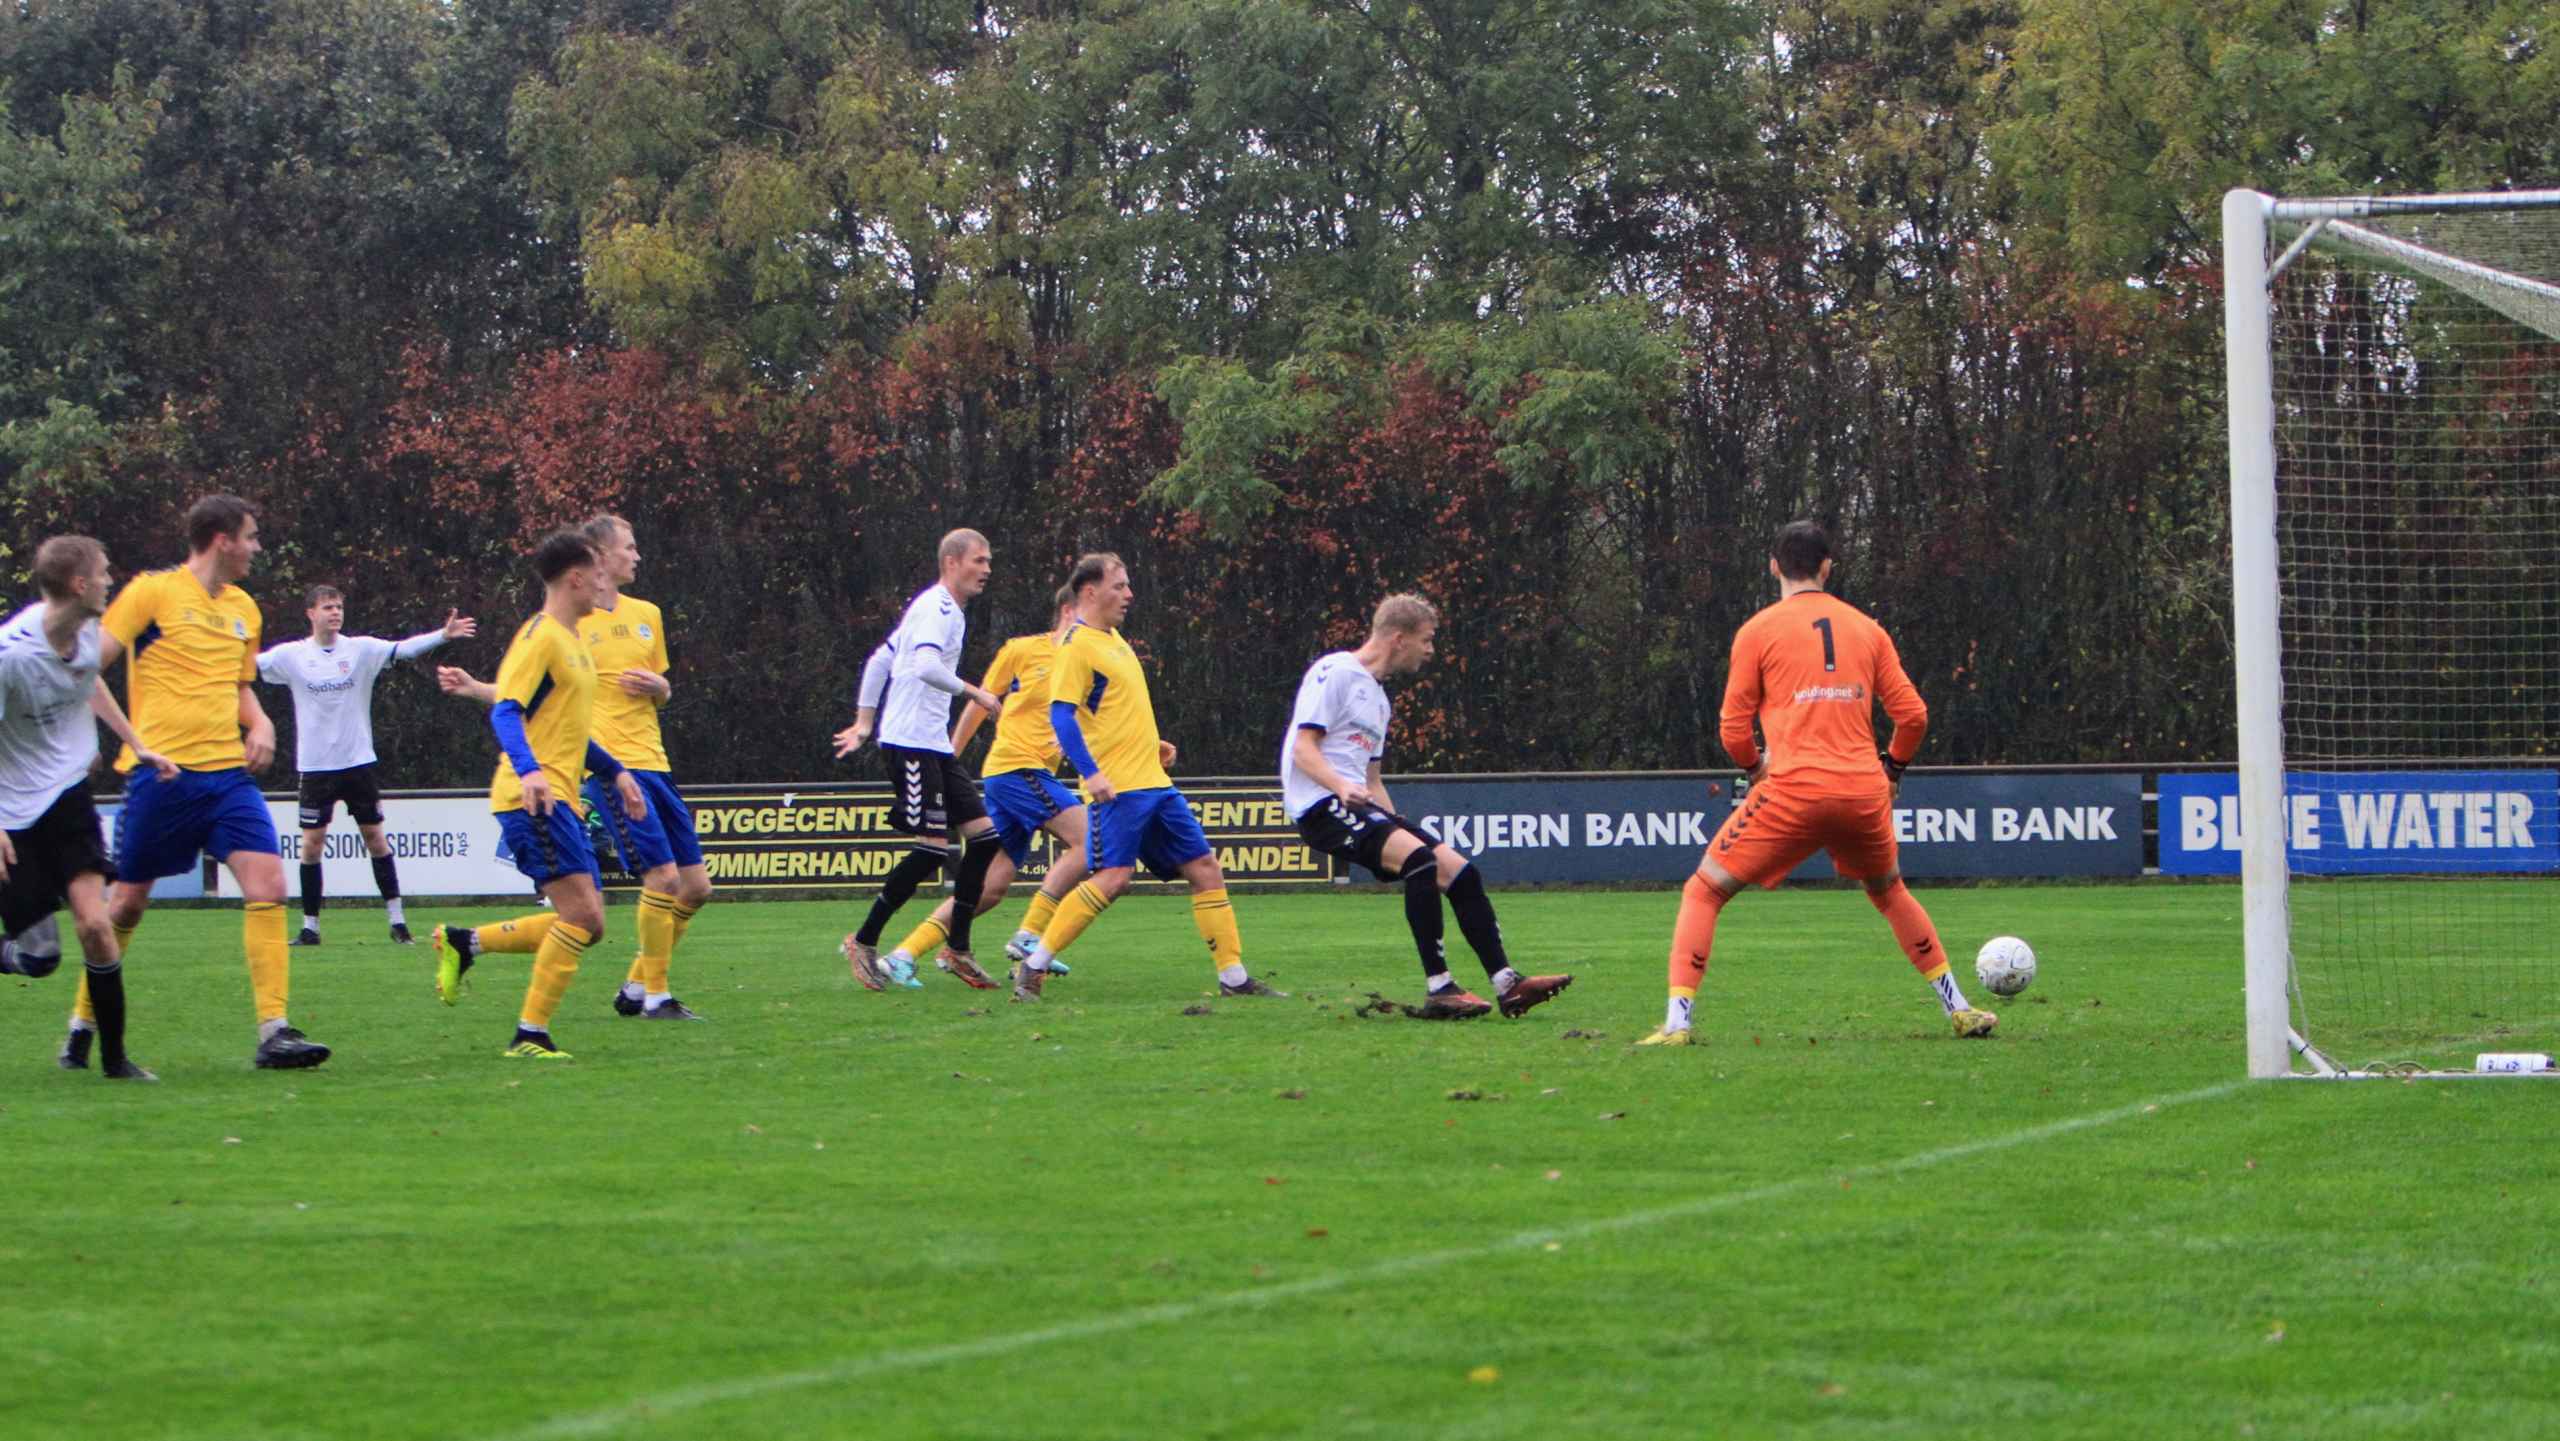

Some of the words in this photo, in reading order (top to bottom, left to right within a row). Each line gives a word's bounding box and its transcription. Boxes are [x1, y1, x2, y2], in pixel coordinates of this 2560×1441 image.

[1812, 617, 1836, 672] 1
[694, 805, 894, 834] BYGGECENTE
[1420, 813, 1570, 857] SKJERN
[1585, 811, 1709, 847] BANK
[1891, 807, 1976, 843] ERN
[1991, 806, 2119, 841] BANK
[2180, 795, 2321, 852] BLE
[2336, 791, 2536, 850] WATER
